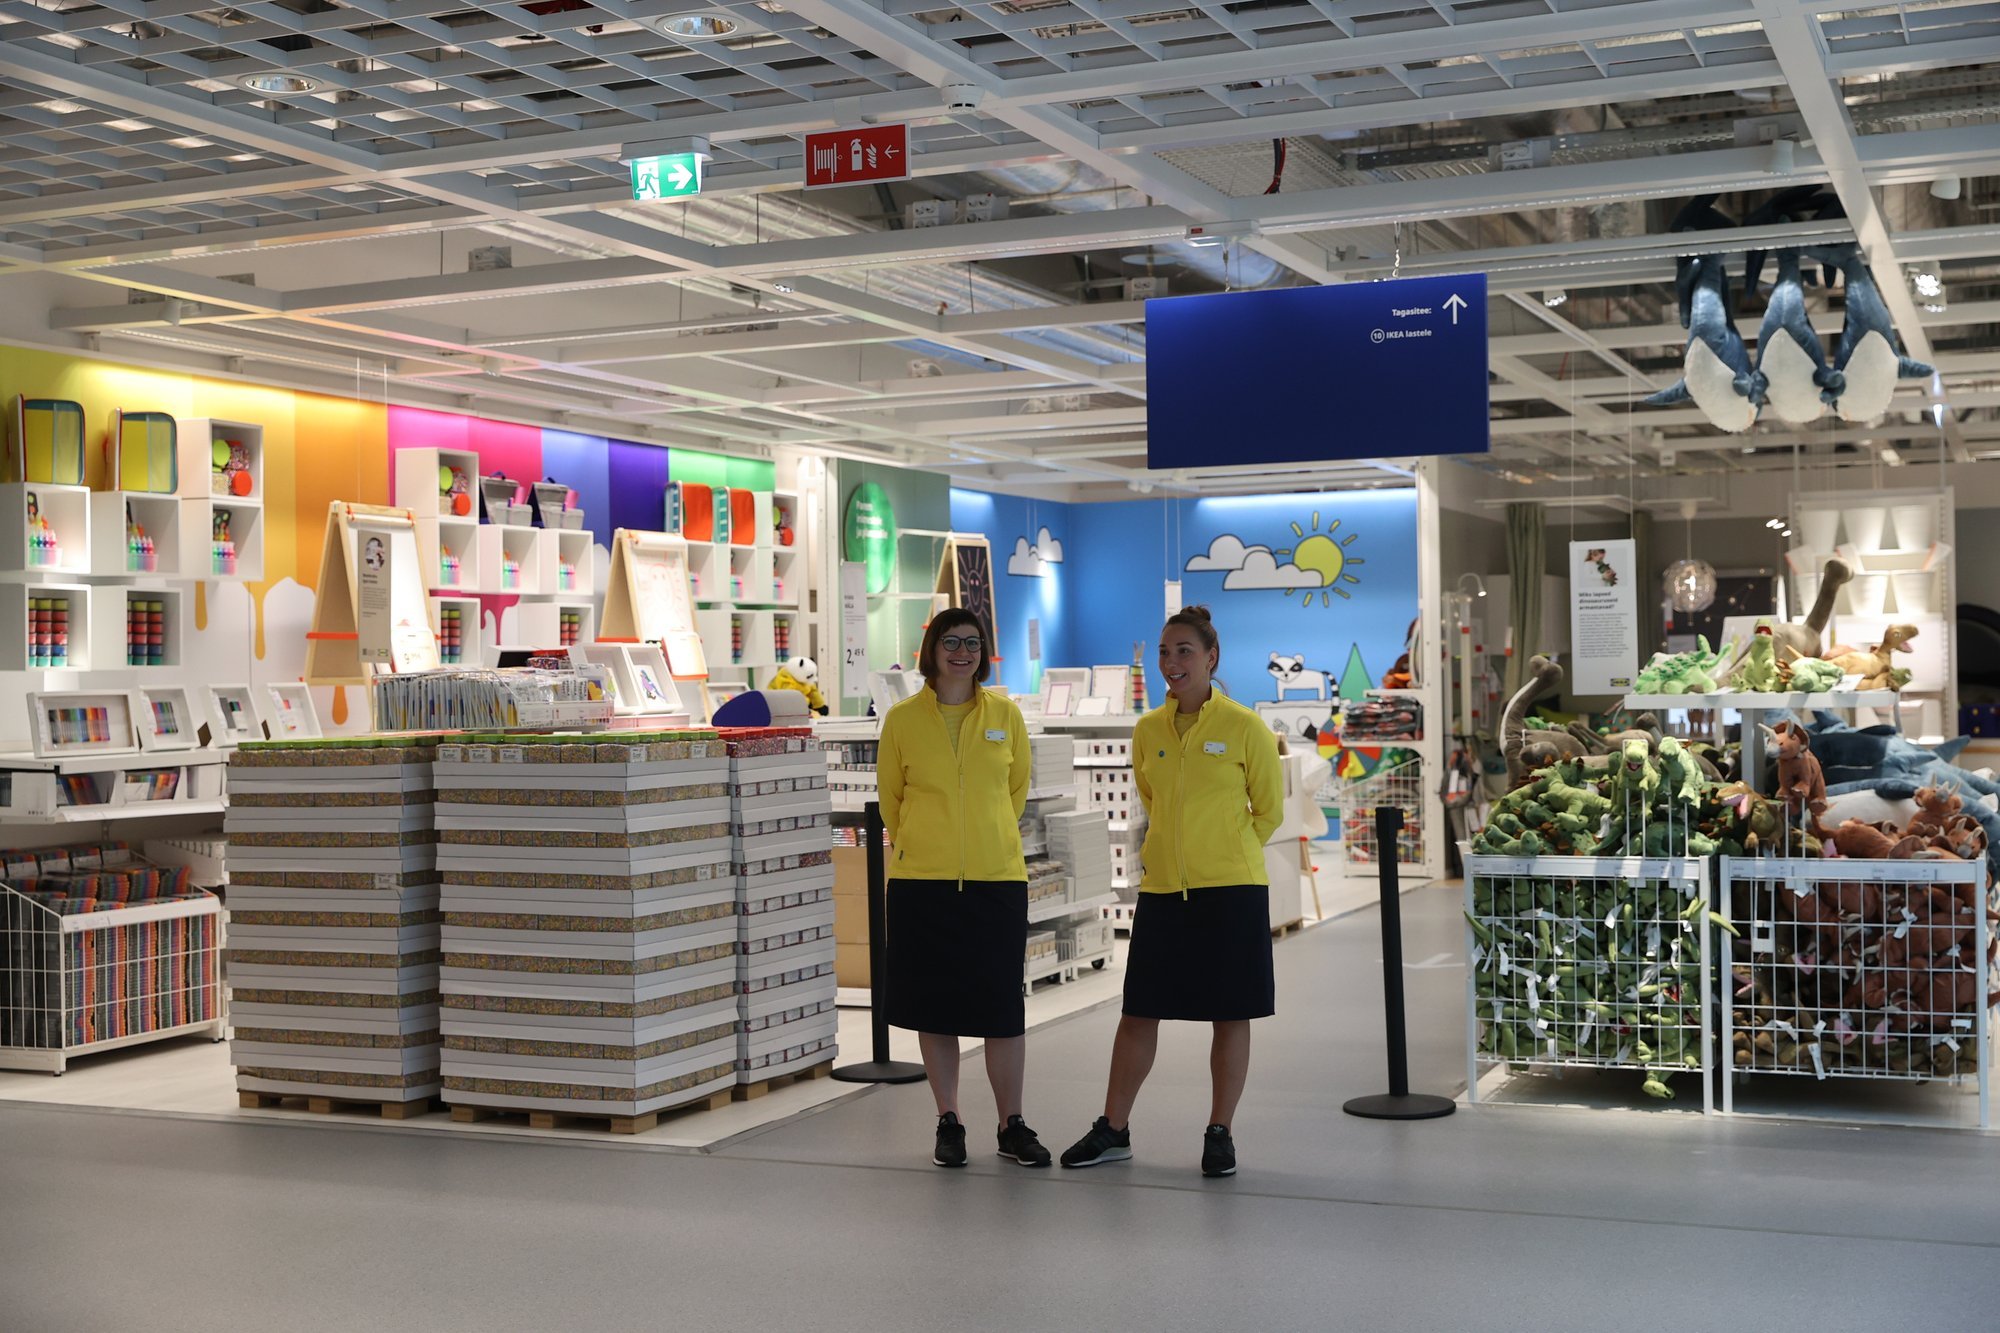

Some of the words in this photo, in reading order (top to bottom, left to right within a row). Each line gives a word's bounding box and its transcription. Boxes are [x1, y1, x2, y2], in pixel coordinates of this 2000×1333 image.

[1391, 307, 1432, 318] Tagasitee:
[1373, 332, 1383, 340] 10
[1386, 331, 1404, 339] IKEA
[1405, 329, 1432, 338] lastele
